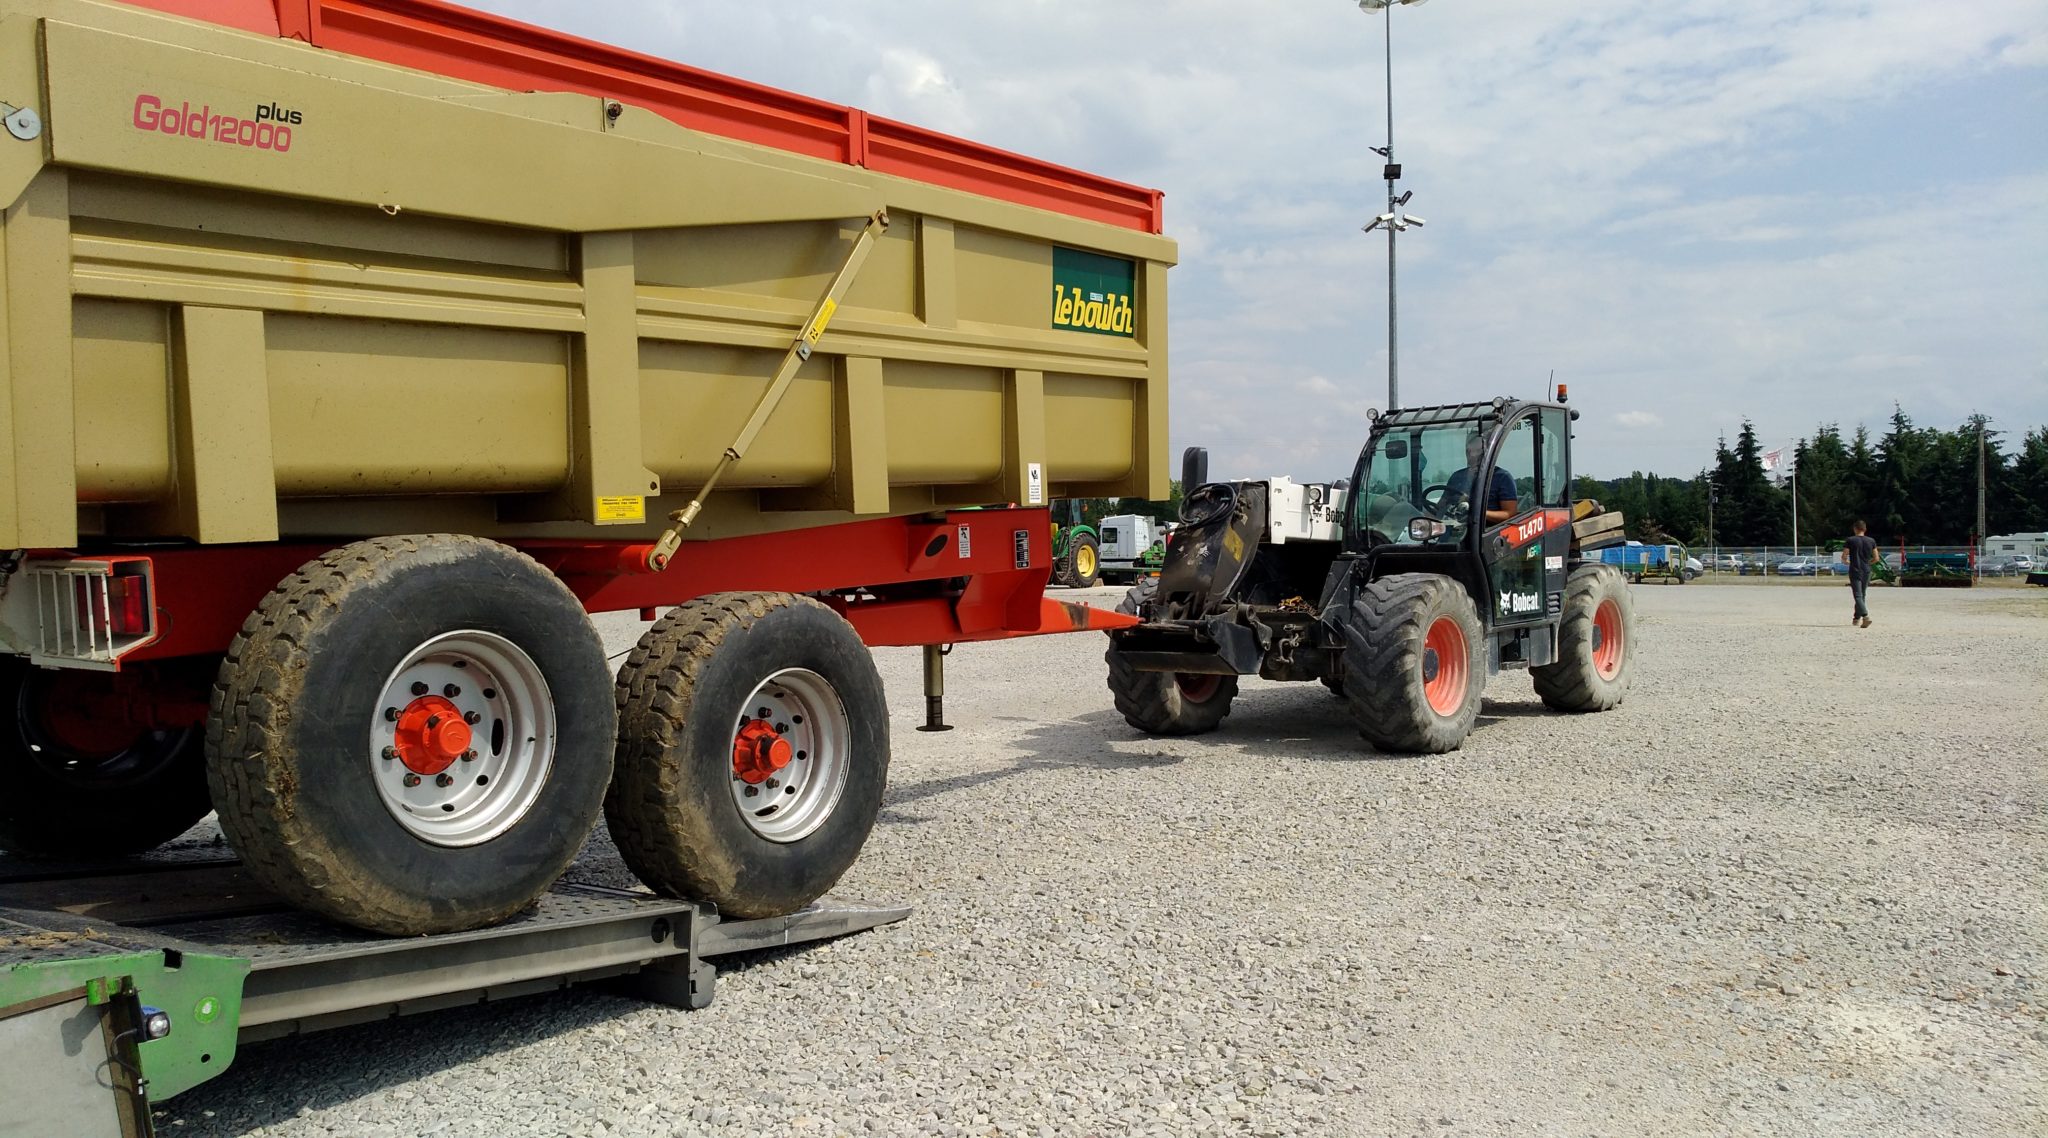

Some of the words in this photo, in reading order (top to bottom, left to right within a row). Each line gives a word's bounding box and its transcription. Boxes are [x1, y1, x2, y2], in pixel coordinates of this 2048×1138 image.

[256, 102, 303, 125] plus
[1518, 516, 1543, 541] TL470
[1512, 592, 1538, 612] Bobcat
